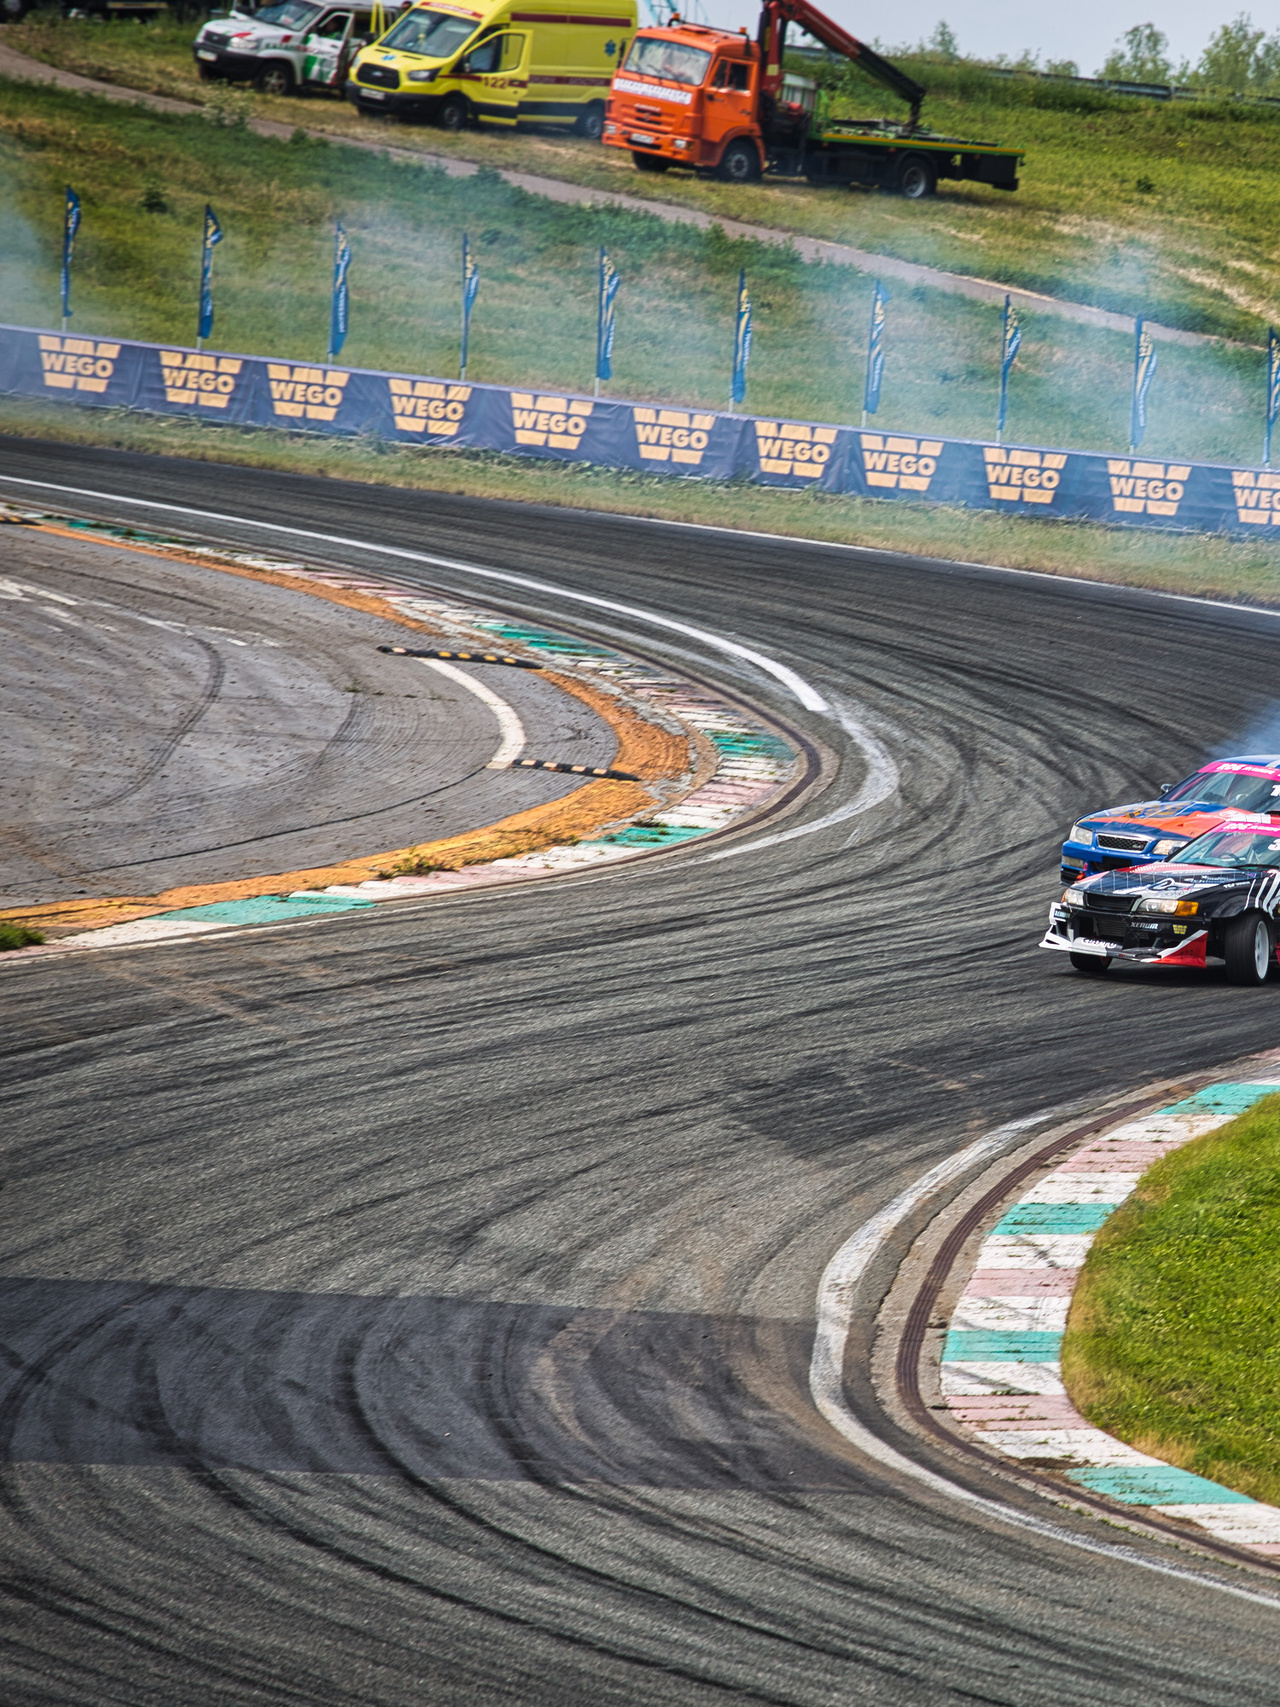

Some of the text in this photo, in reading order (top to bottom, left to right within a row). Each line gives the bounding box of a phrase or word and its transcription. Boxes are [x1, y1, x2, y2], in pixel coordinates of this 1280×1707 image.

[42, 353, 114, 377] WEGO
[164, 369, 235, 392] WEGO
[272, 381, 344, 406] WEGO
[393, 396, 465, 421] WEGO
[514, 409, 586, 435] WEGO
[637, 423, 708, 450] WEGO
[758, 438, 830, 464] WEGO
[864, 451, 938, 476] WEGO
[987, 464, 1060, 489] WEGO
[1111, 476, 1184, 501] WEGO
